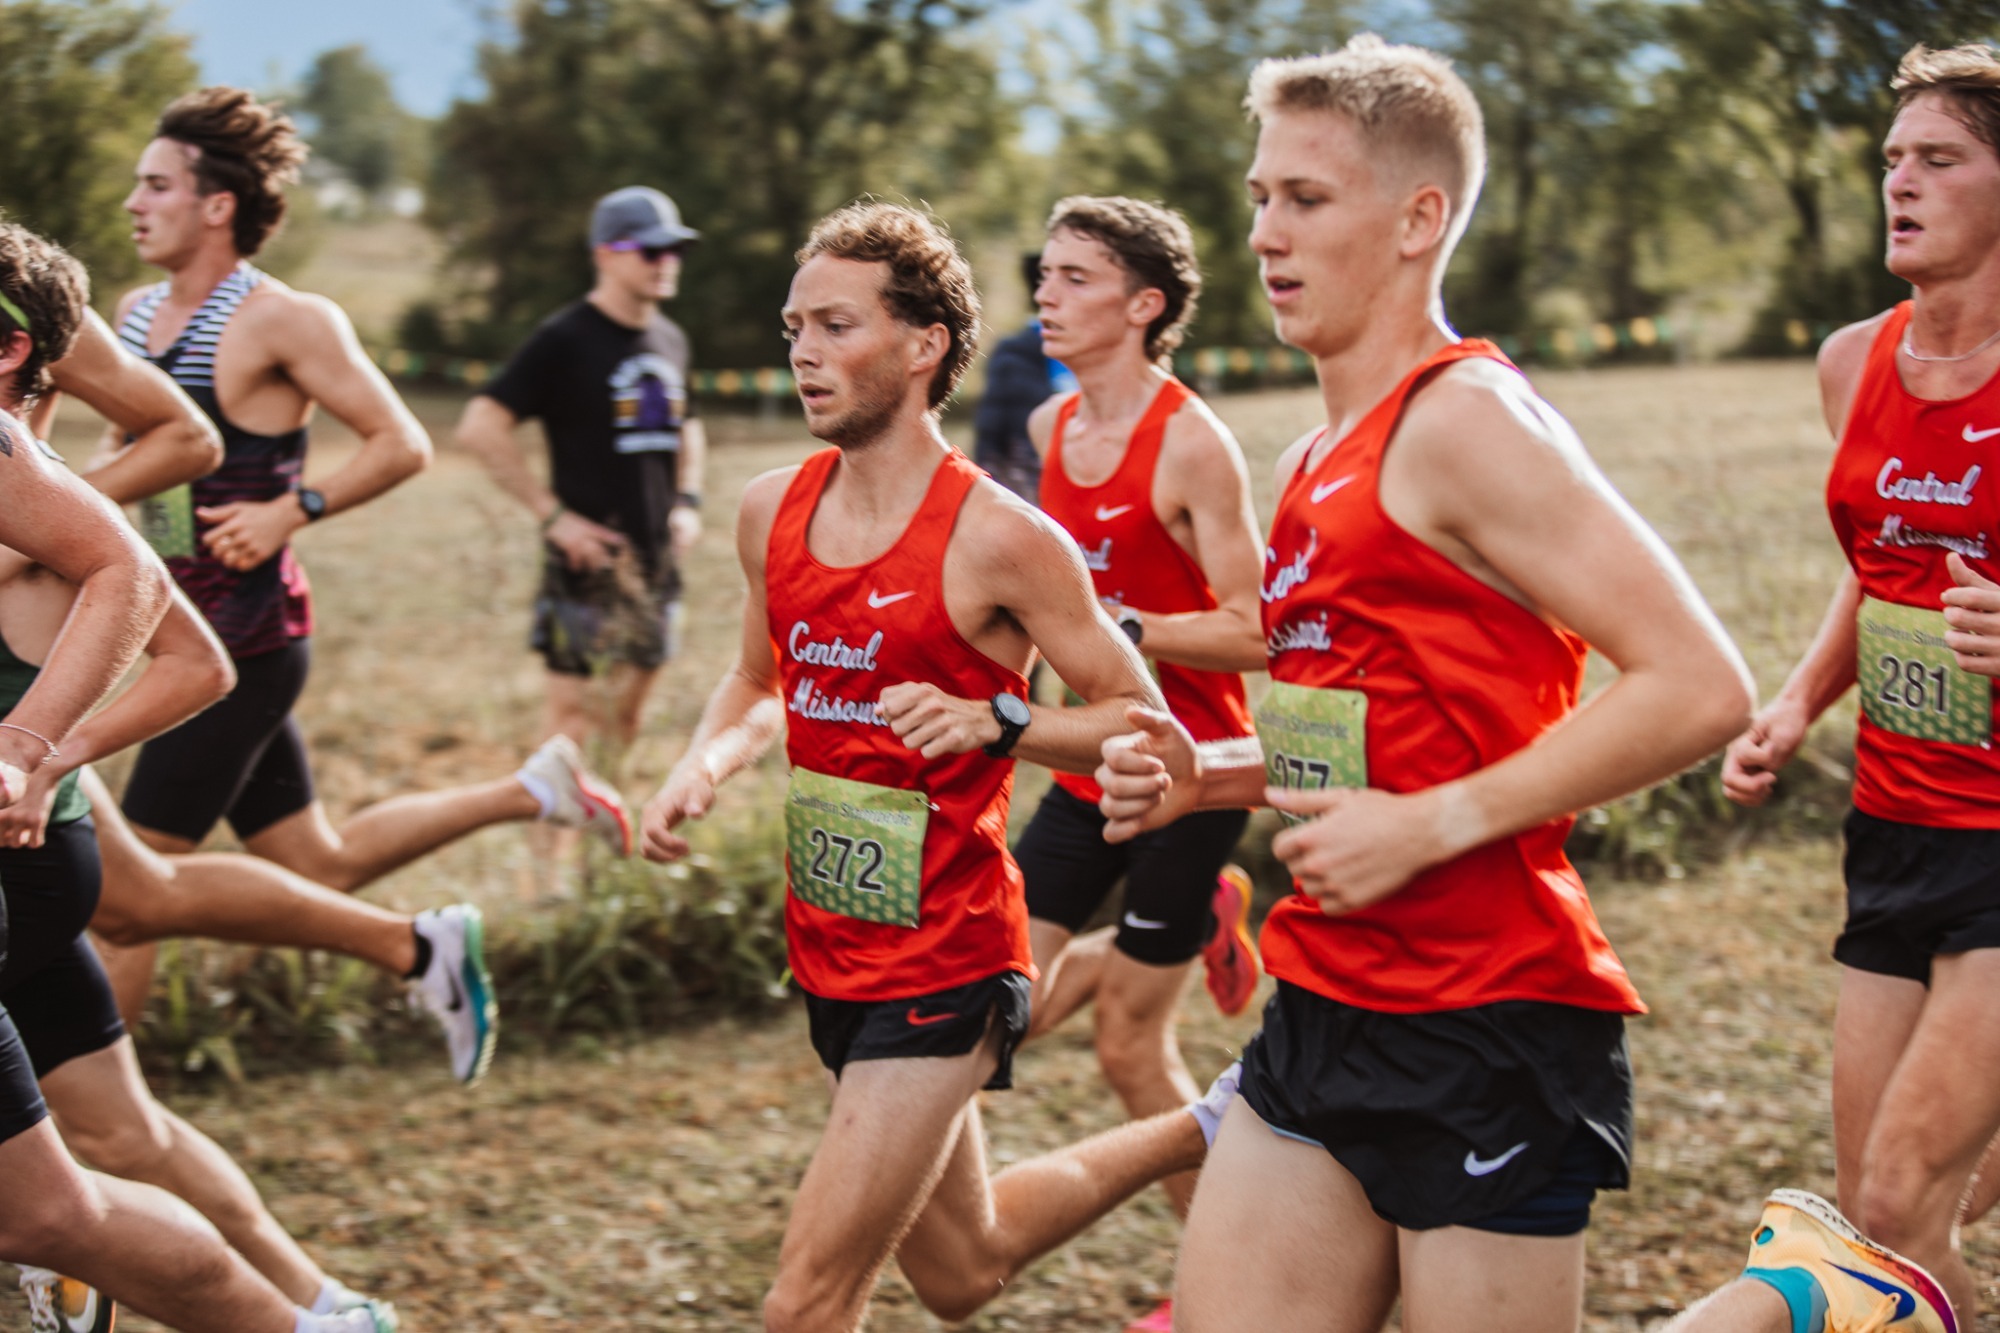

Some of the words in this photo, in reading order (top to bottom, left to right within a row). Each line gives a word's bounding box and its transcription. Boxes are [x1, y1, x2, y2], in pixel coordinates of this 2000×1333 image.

[1876, 456, 1981, 507] Central
[788, 620, 884, 672] Central
[788, 676, 889, 727] Missour
[1879, 653, 1950, 716] 281
[809, 827, 886, 895] 272
